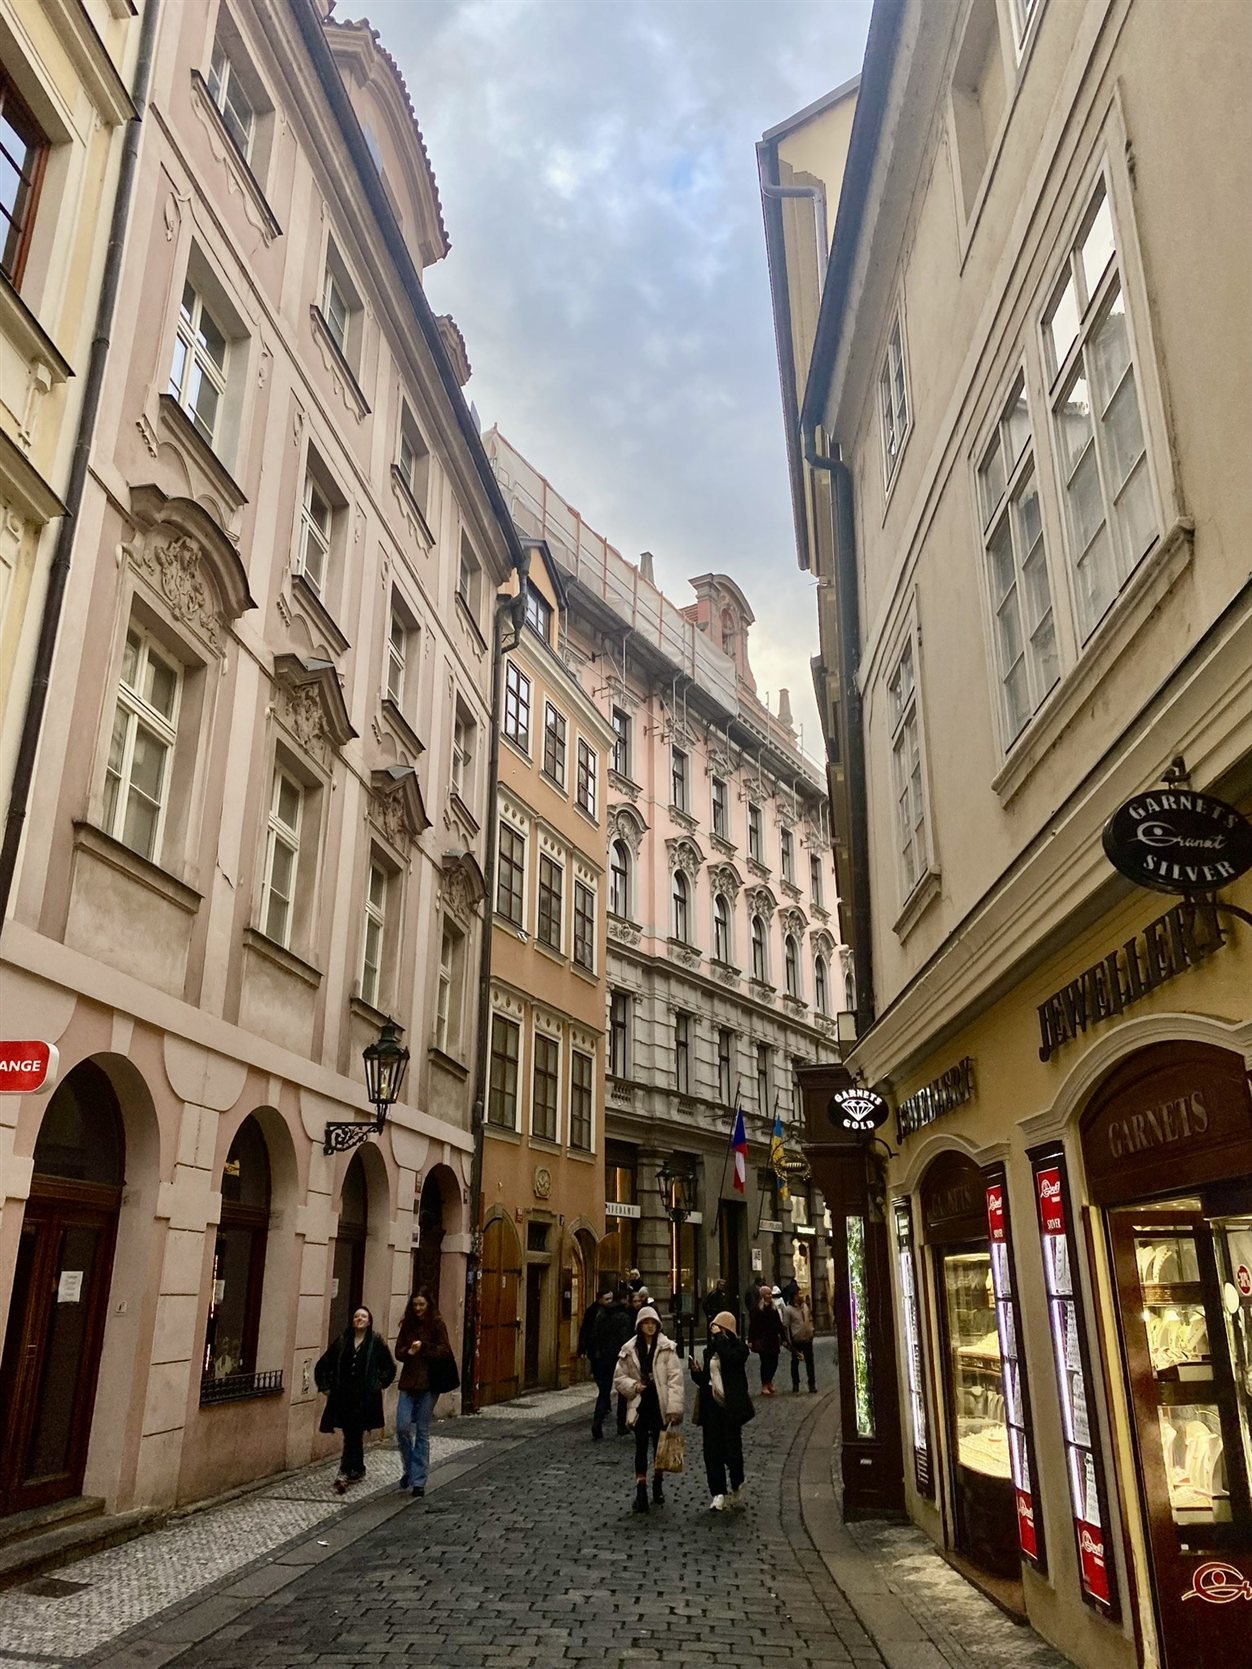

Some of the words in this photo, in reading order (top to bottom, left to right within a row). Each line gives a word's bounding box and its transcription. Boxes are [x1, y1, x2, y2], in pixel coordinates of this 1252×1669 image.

[1128, 794, 1239, 829] GARNETS
[1143, 854, 1236, 882] SILVER
[1036, 891, 1227, 1062] JEWELLERY
[0, 1060, 42, 1072] ANGE
[834, 1088, 883, 1106] GARNETS
[842, 1118, 875, 1130] GOLD
[1108, 1090, 1208, 1159] GARNETS
